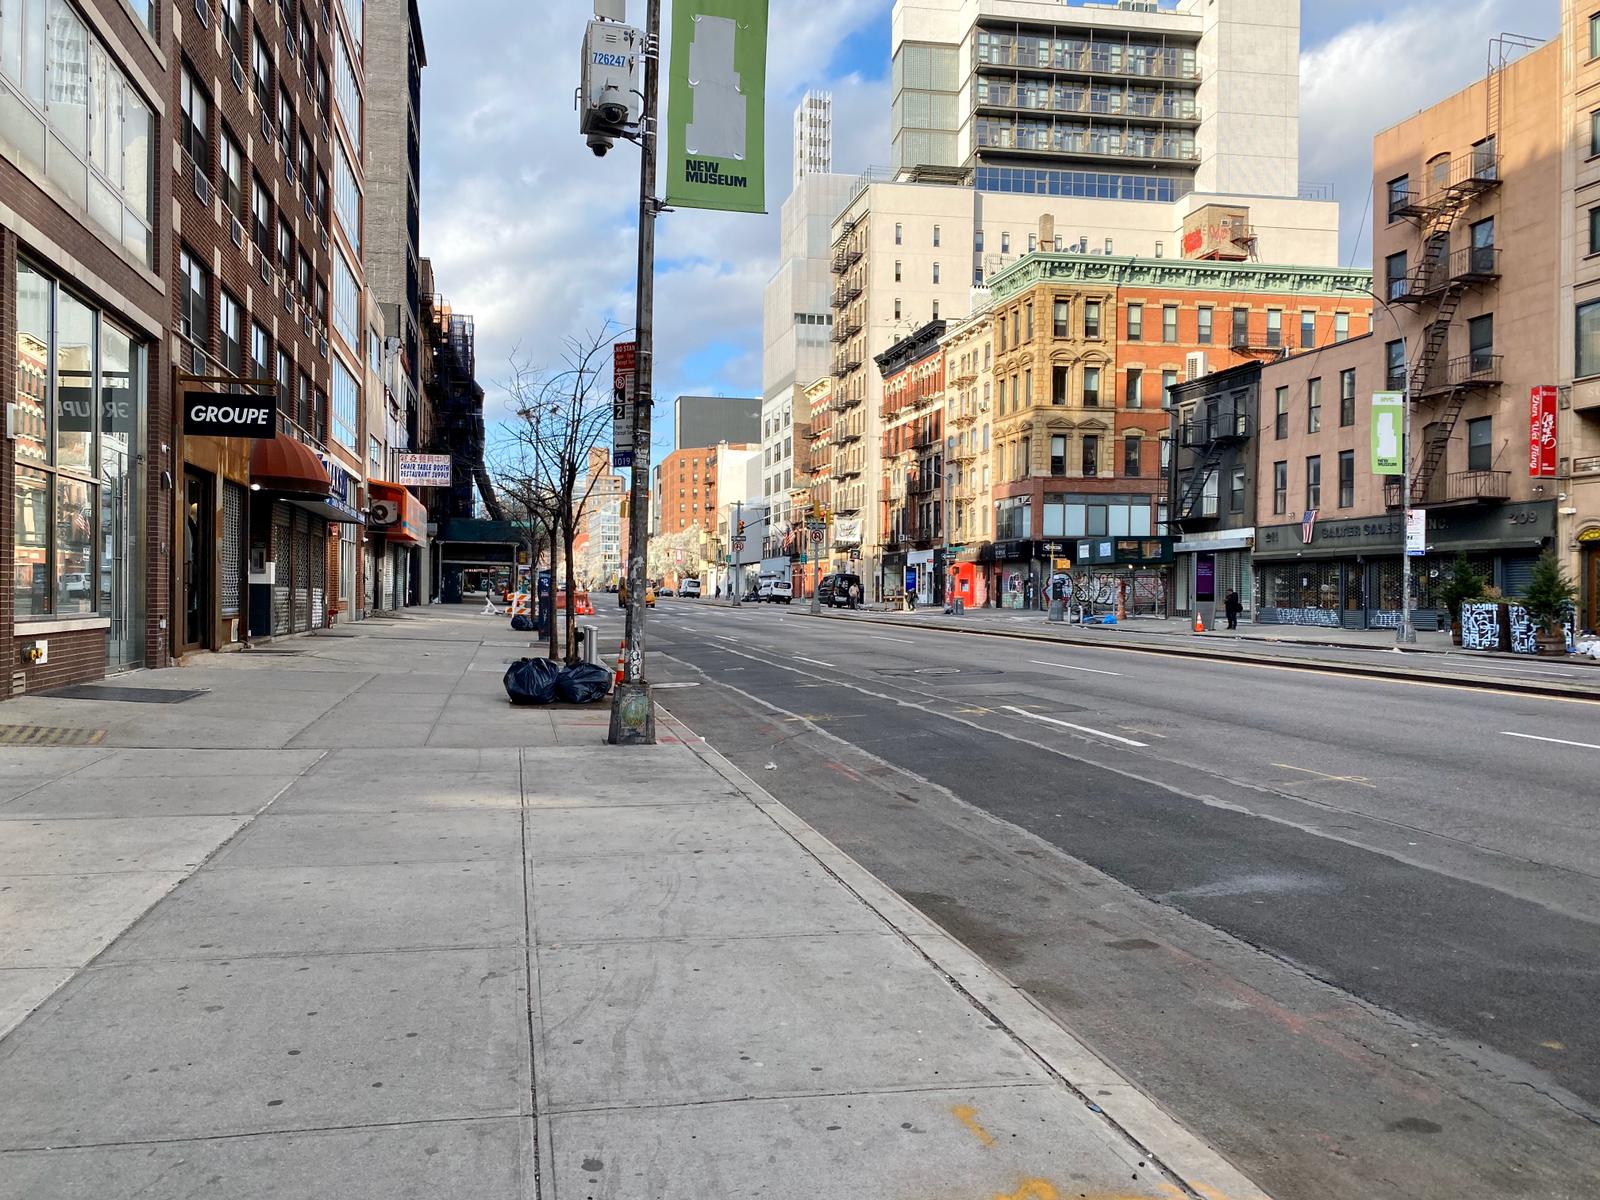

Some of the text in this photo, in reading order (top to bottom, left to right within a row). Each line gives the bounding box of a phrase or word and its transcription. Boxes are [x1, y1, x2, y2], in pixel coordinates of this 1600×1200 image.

[592, 52, 626, 67] 726247
[685, 159, 719, 174] NEW
[685, 171, 747, 188] MUSEUM
[190, 404, 270, 426] GROUPE
[616, 406, 623, 419] 2
[400, 463, 416, 471] CHAIR
[614, 457, 631, 467] 1019
[1508, 510, 1538, 526] 209
[1363, 523, 1400, 536] SALES
